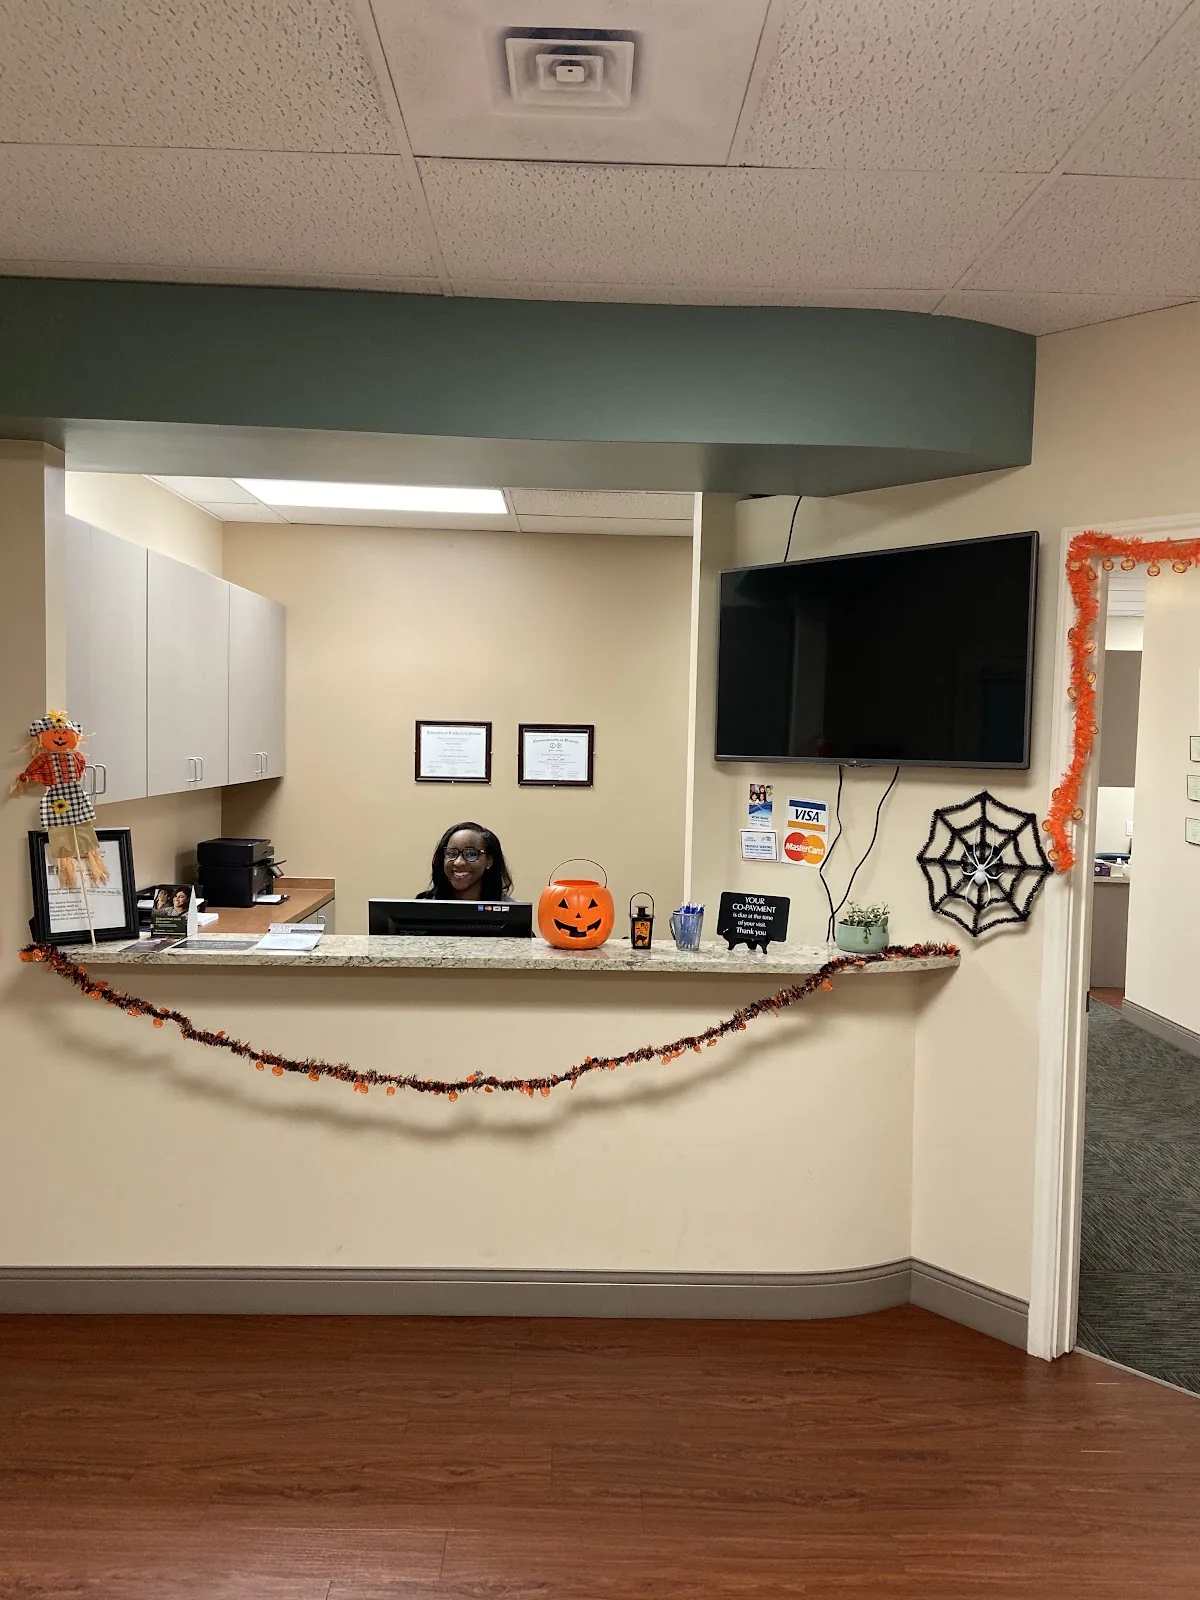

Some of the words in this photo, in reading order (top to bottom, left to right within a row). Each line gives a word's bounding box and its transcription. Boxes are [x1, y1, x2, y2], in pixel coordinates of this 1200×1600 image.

[795, 809, 820, 822] VISA
[785, 842, 825, 855] MasterCard
[732, 903, 777, 913] CO-PAYMENT
